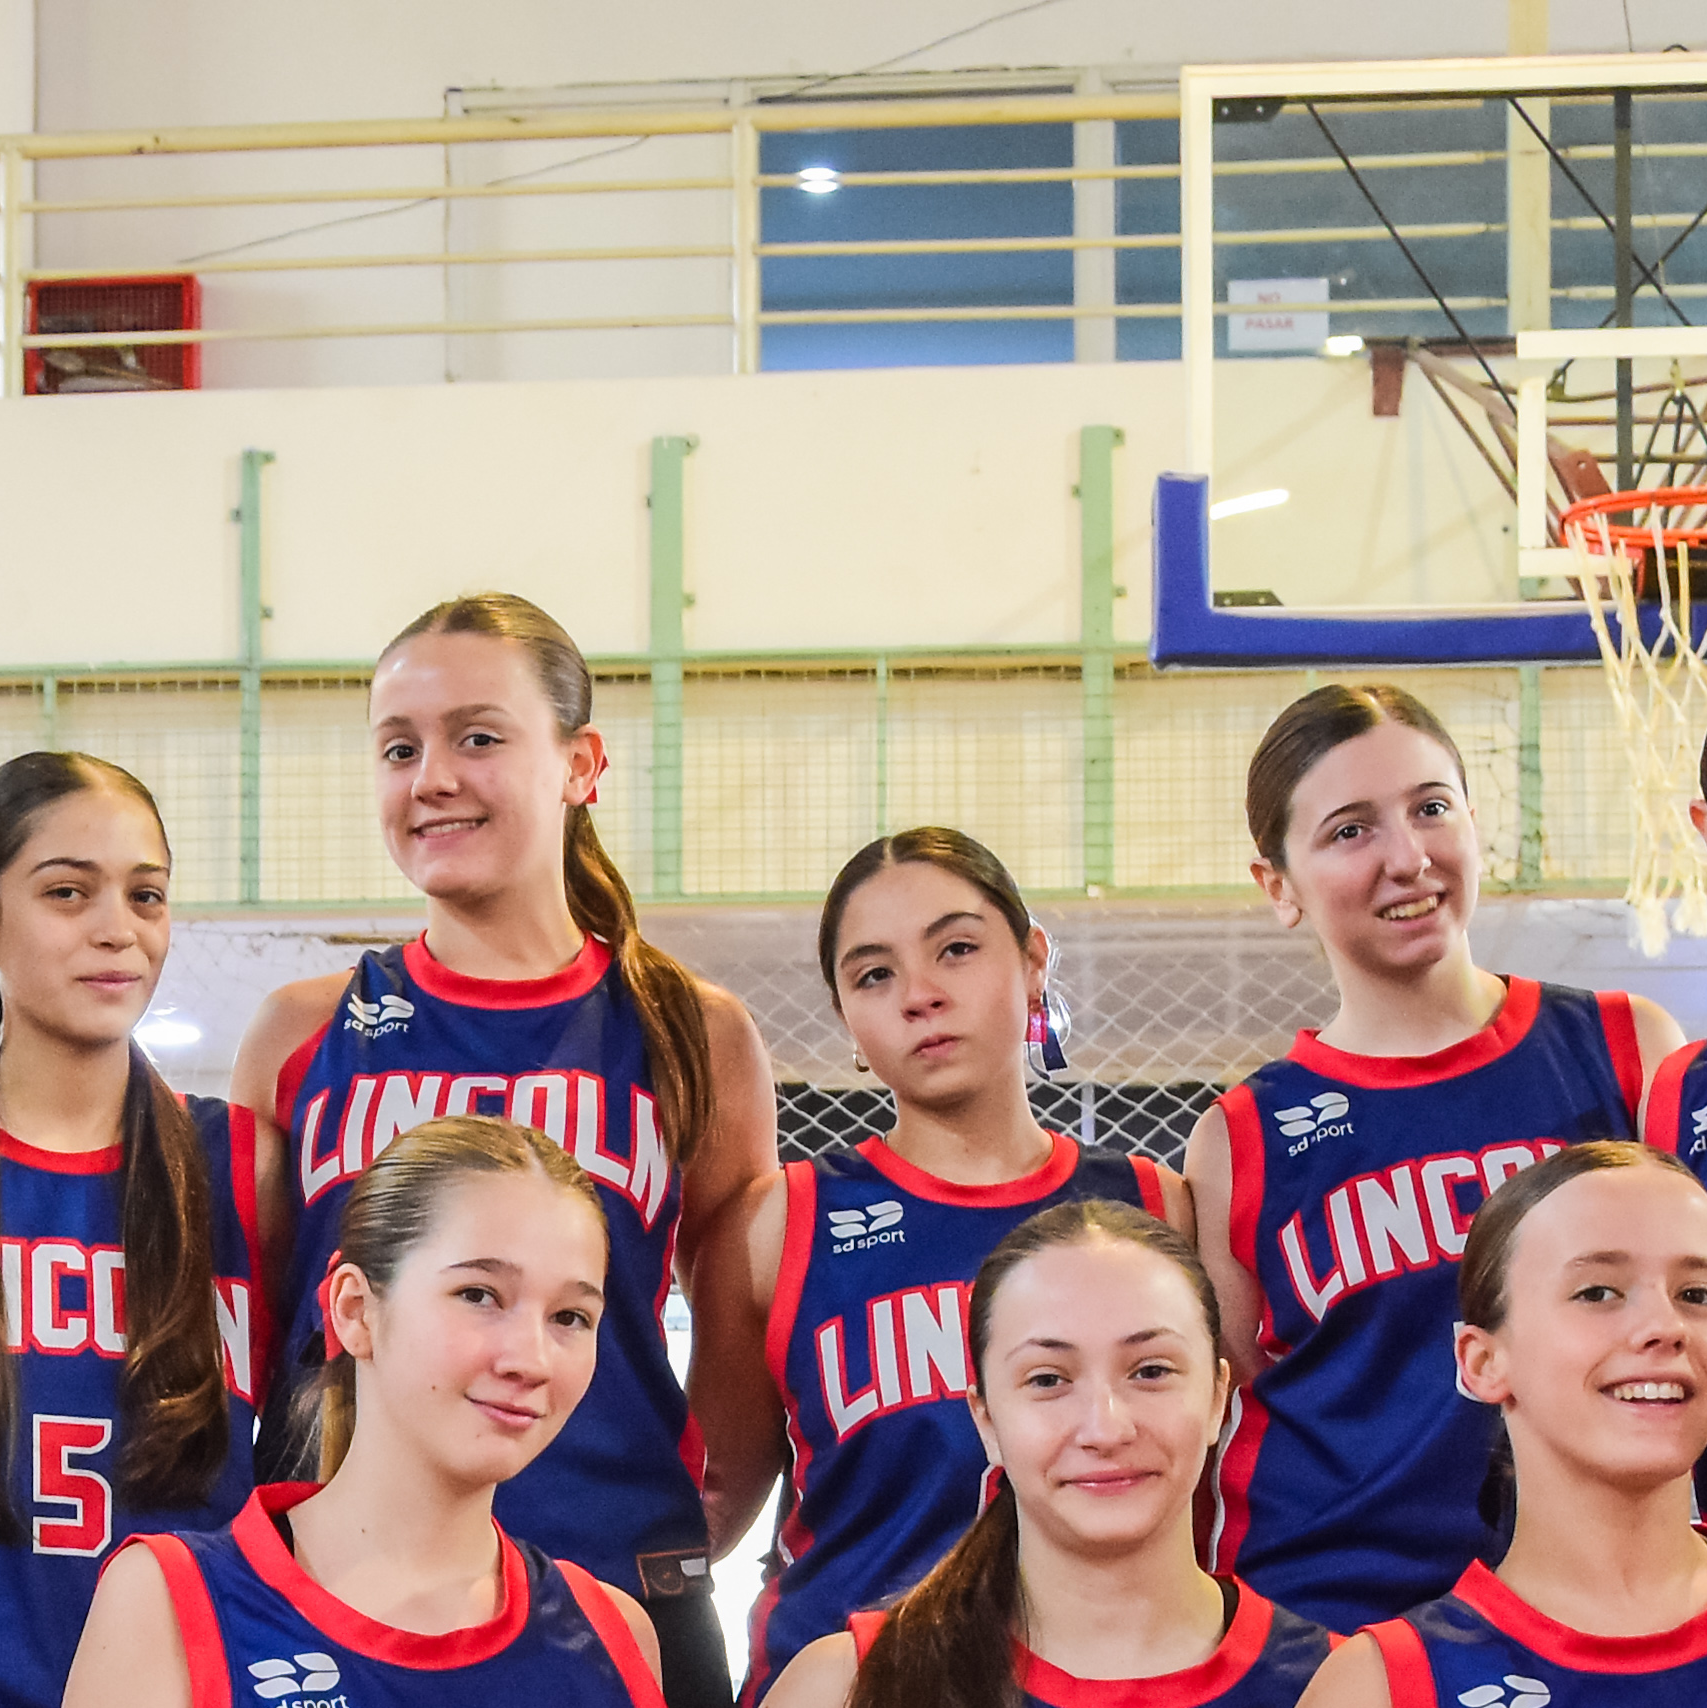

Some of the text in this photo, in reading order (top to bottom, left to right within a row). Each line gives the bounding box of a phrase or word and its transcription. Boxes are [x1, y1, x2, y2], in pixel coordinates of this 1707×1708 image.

[1288, 1135, 1309, 1158] sd
[832, 1229, 906, 1254] sd sport
[1277, 1137, 1570, 1323] LINC
[32, 1413, 113, 1557] 5
